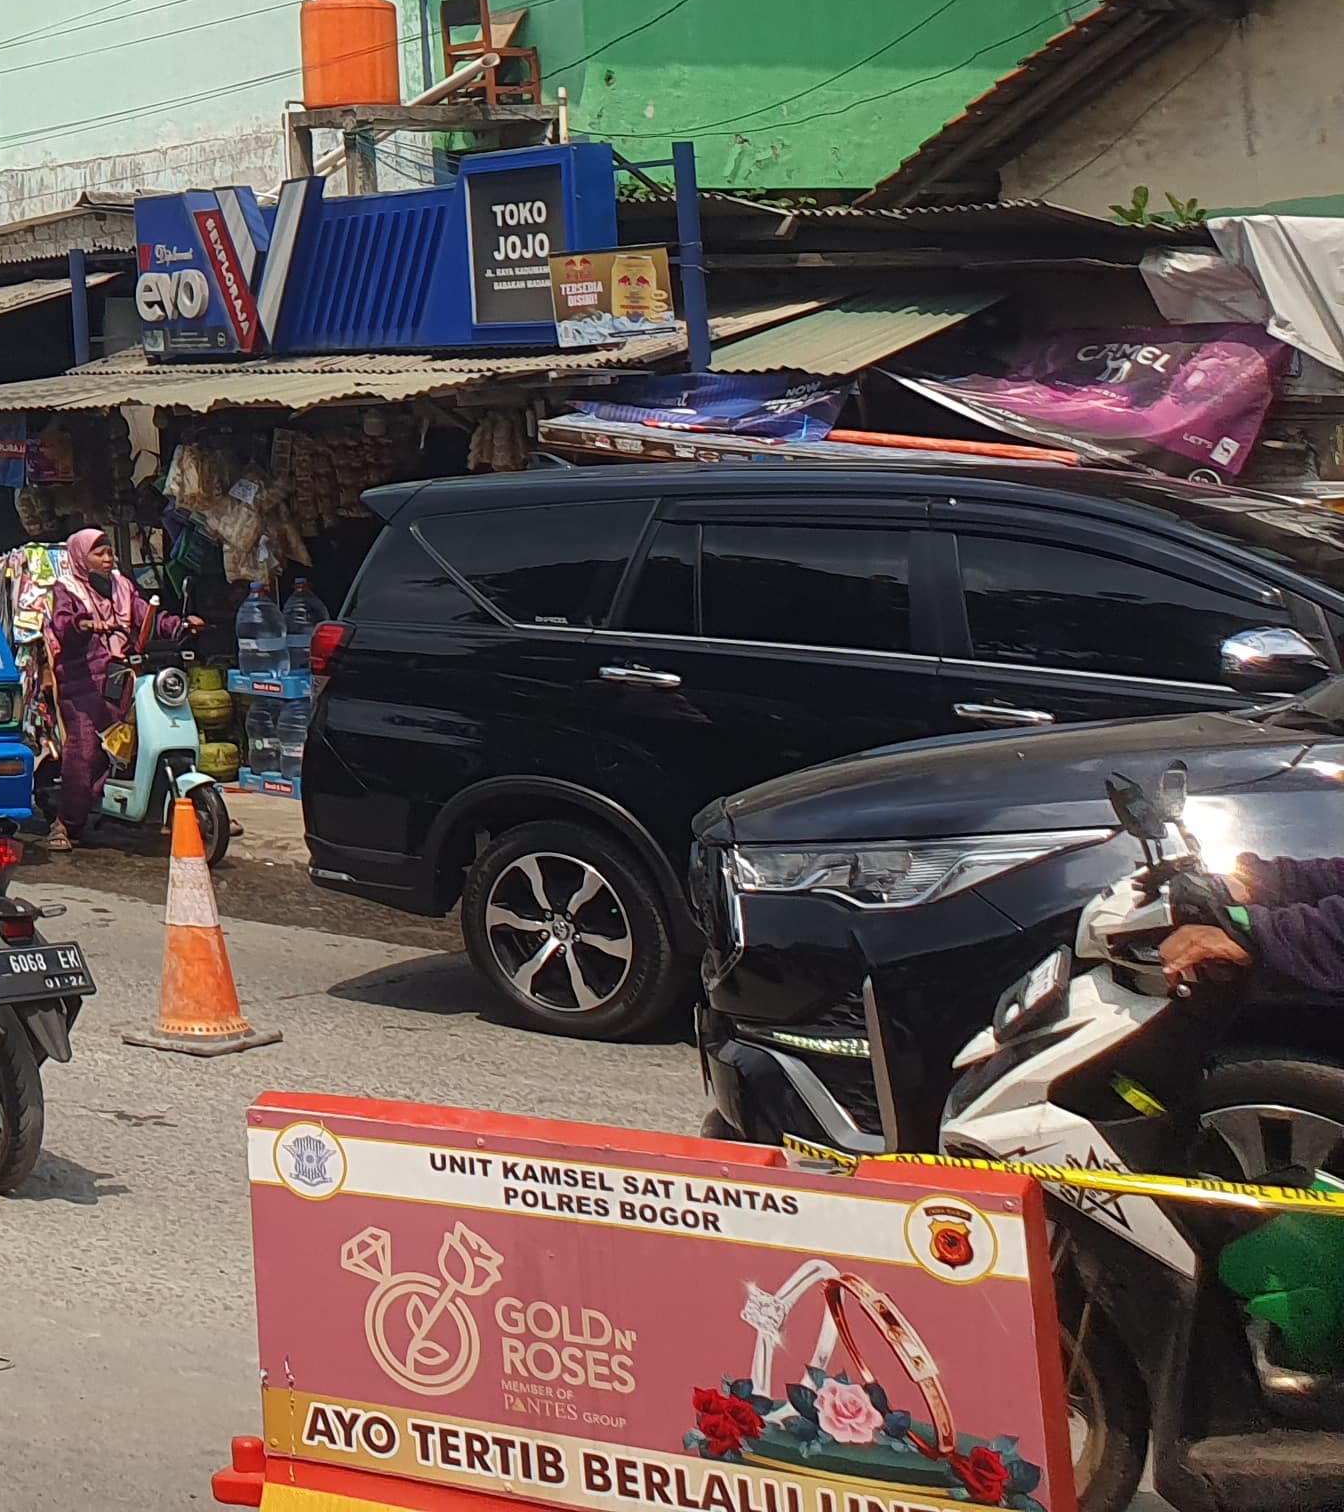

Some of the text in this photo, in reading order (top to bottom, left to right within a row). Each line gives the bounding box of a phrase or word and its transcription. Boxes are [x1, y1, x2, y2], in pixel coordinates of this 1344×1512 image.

[492, 200, 547, 227] TOKO
[493, 233, 550, 261] JOJO
[136, 269, 209, 321] evo
[560, 280, 603, 295] TERSEDIA
[1076, 343, 1172, 373] CAMEL
[10, 953, 47, 973] 6068
[57, 950, 79, 968] EK
[429, 1153, 800, 1216] UNIT KAMSEL SAT LANTAS
[1185, 1179, 1336, 1202] POLICE LINE
[503, 1186, 722, 1233] POLRES BOGOR
[495, 1296, 612, 1346] GOLD
[502, 1337, 636, 1393] ROSES
[501, 1379, 574, 1400] MEMBER OF
[583, 1412, 626, 1428] GROUP
[306, 1407, 800, 1512] AYO TERTIB BERLALU
